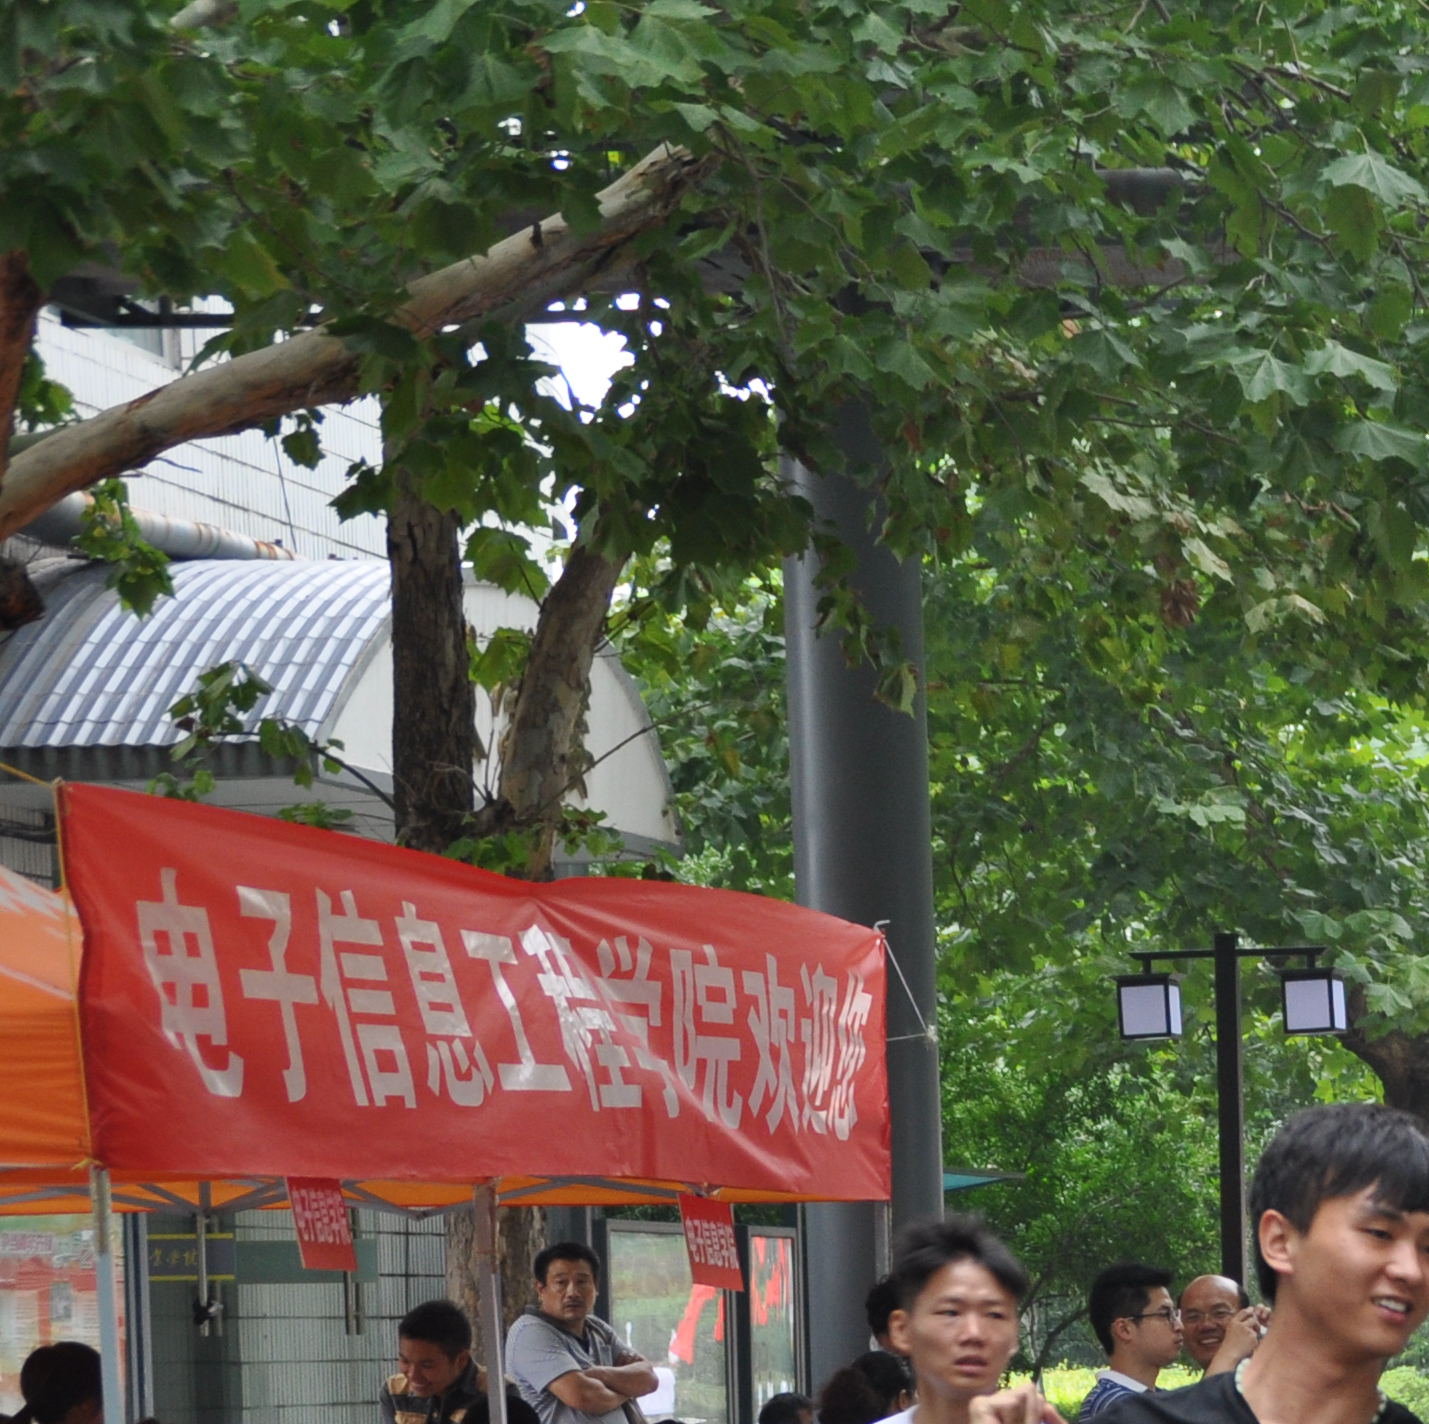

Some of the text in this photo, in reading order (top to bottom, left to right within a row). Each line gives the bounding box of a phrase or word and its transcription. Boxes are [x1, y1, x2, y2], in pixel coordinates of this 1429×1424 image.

[136, 866, 873, 1143] 电子信息工程学院欢迎您
